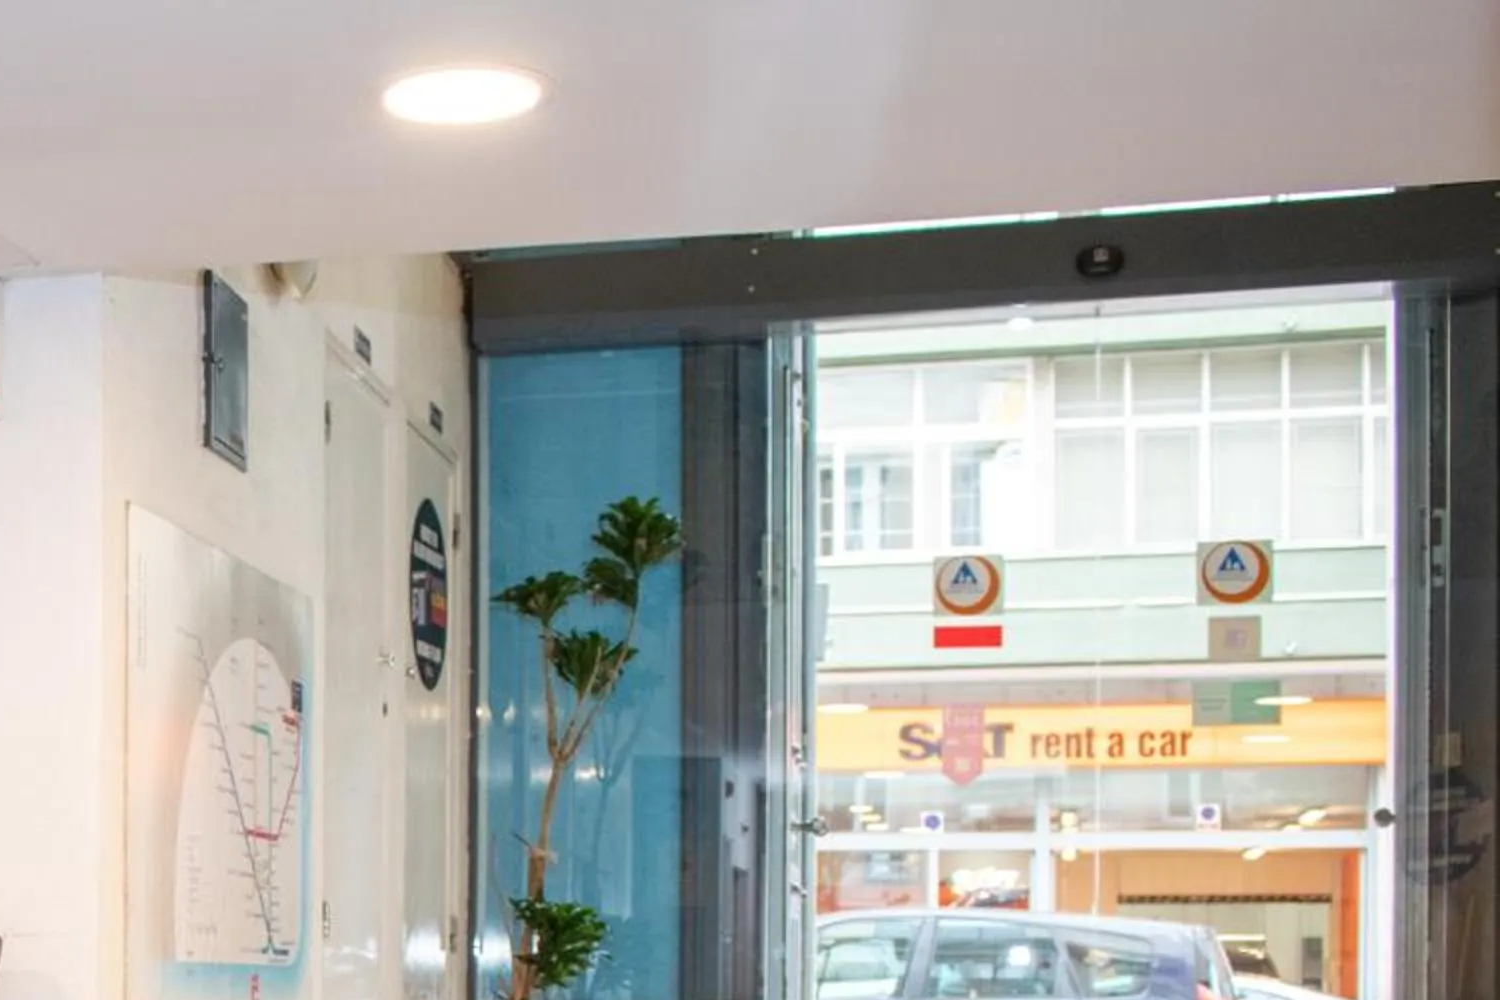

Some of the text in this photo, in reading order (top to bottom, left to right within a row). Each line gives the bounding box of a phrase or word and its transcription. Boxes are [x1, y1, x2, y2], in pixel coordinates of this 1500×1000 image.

[1030, 727, 1096, 759] rent
[1107, 730, 1125, 758] a
[1138, 729, 1193, 758] car
